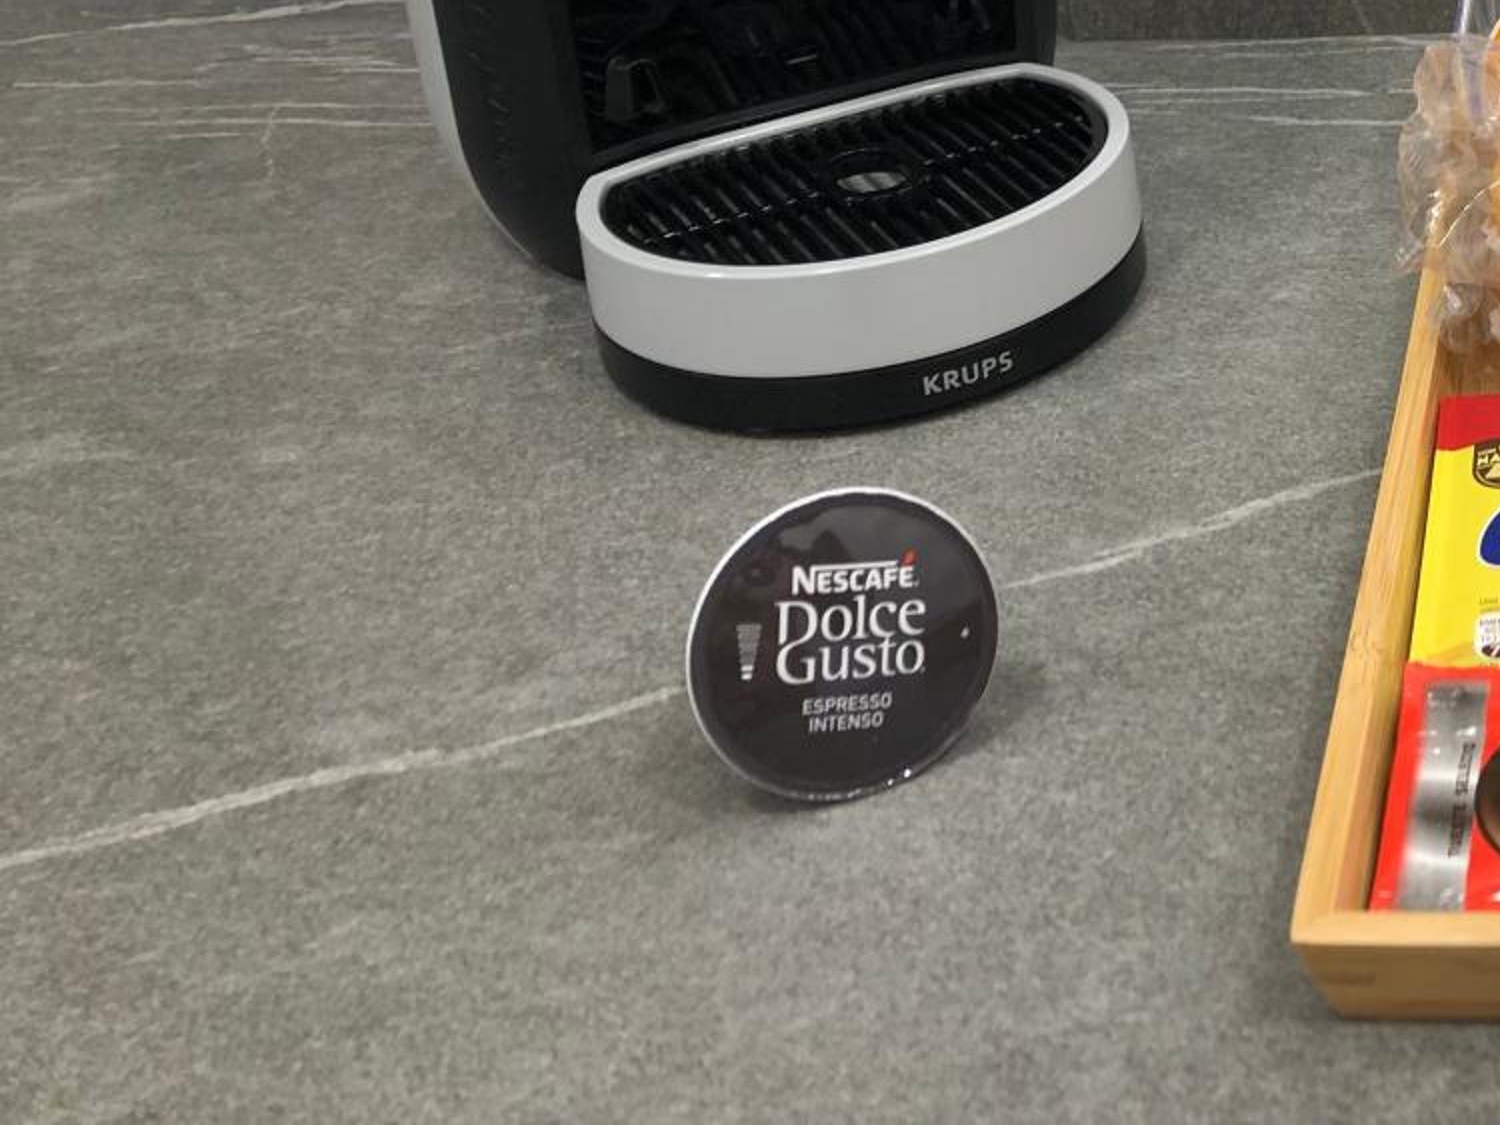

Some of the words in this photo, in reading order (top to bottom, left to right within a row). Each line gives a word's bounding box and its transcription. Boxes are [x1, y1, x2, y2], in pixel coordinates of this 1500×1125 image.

[922, 350, 1013, 396] KRUPS
[774, 595, 926, 645] Dolce
[776, 633, 928, 685] Gusto
[802, 692, 893, 716] ESPRESSO
[808, 711, 884, 733] INTENSO
